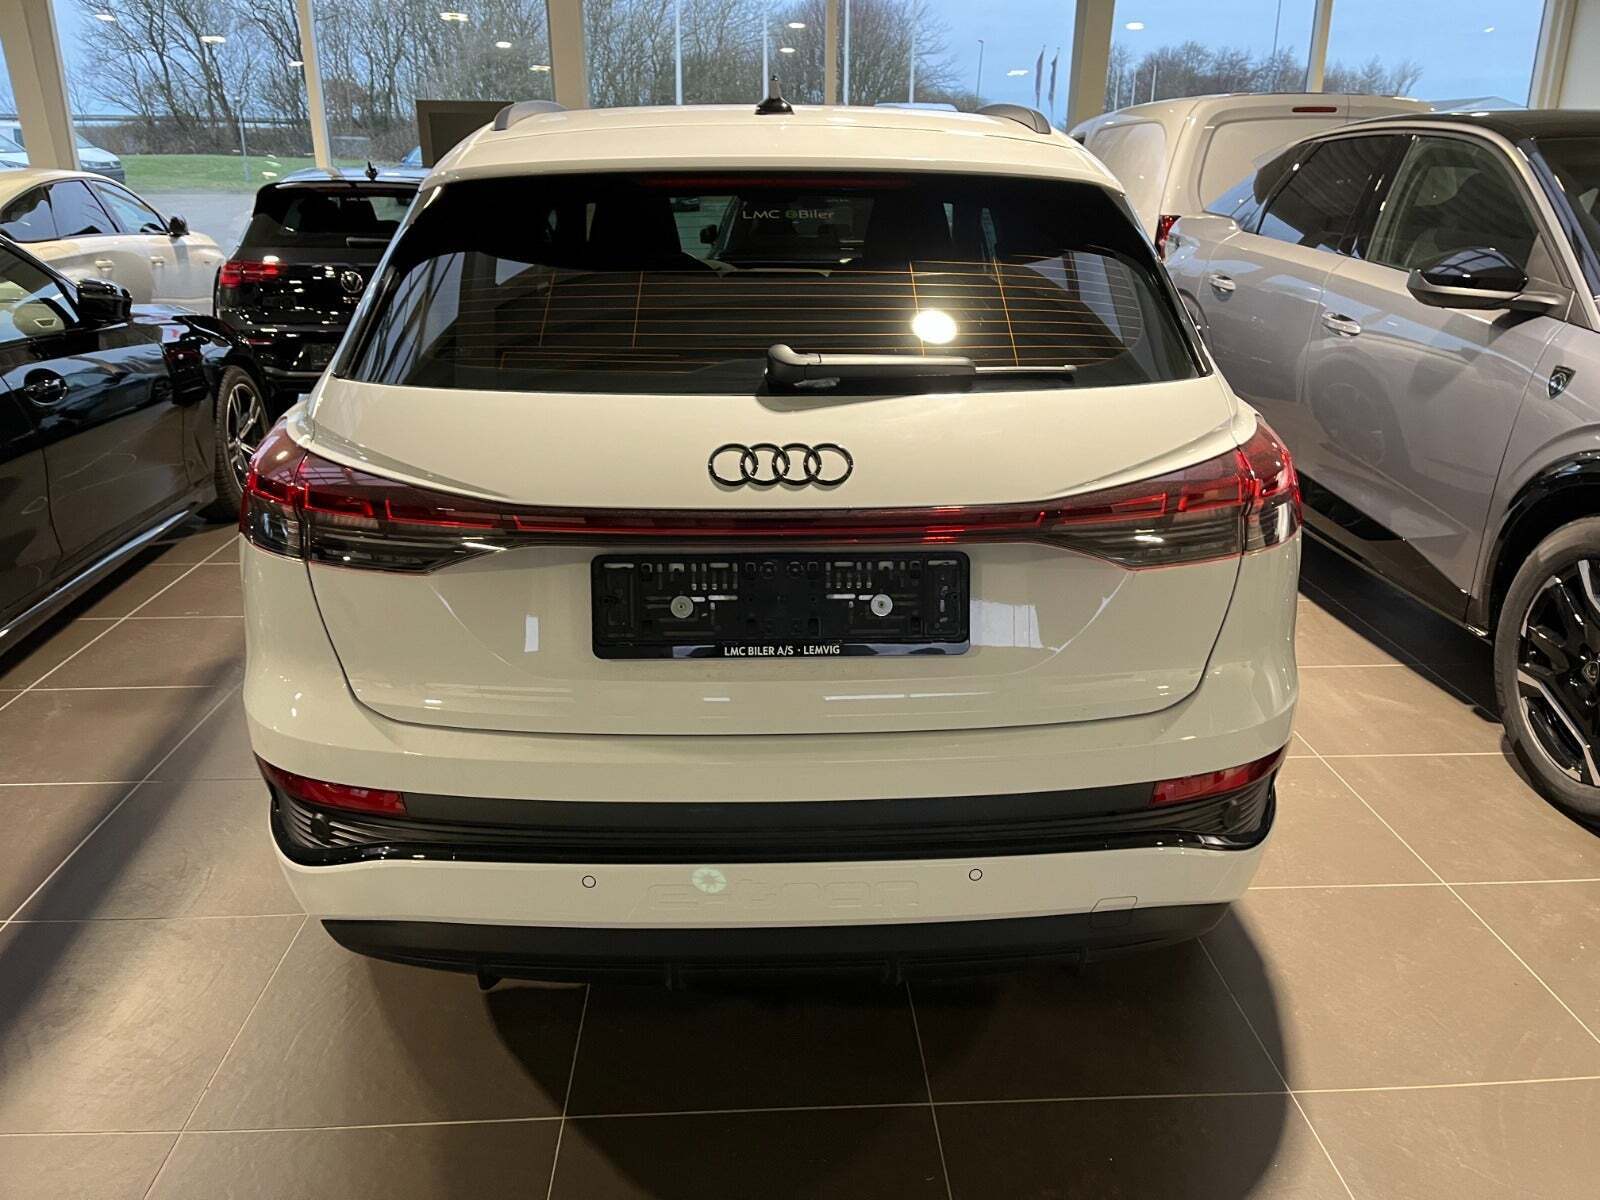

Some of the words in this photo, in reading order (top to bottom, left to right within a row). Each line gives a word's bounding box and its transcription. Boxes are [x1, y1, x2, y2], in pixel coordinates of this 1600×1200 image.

[743, 210, 780, 220] LMC
[724, 645, 746, 656] LMC
[748, 645, 775, 656] BILER
[777, 645, 794, 656] A/S
[803, 644, 840, 655] LEMVIG
